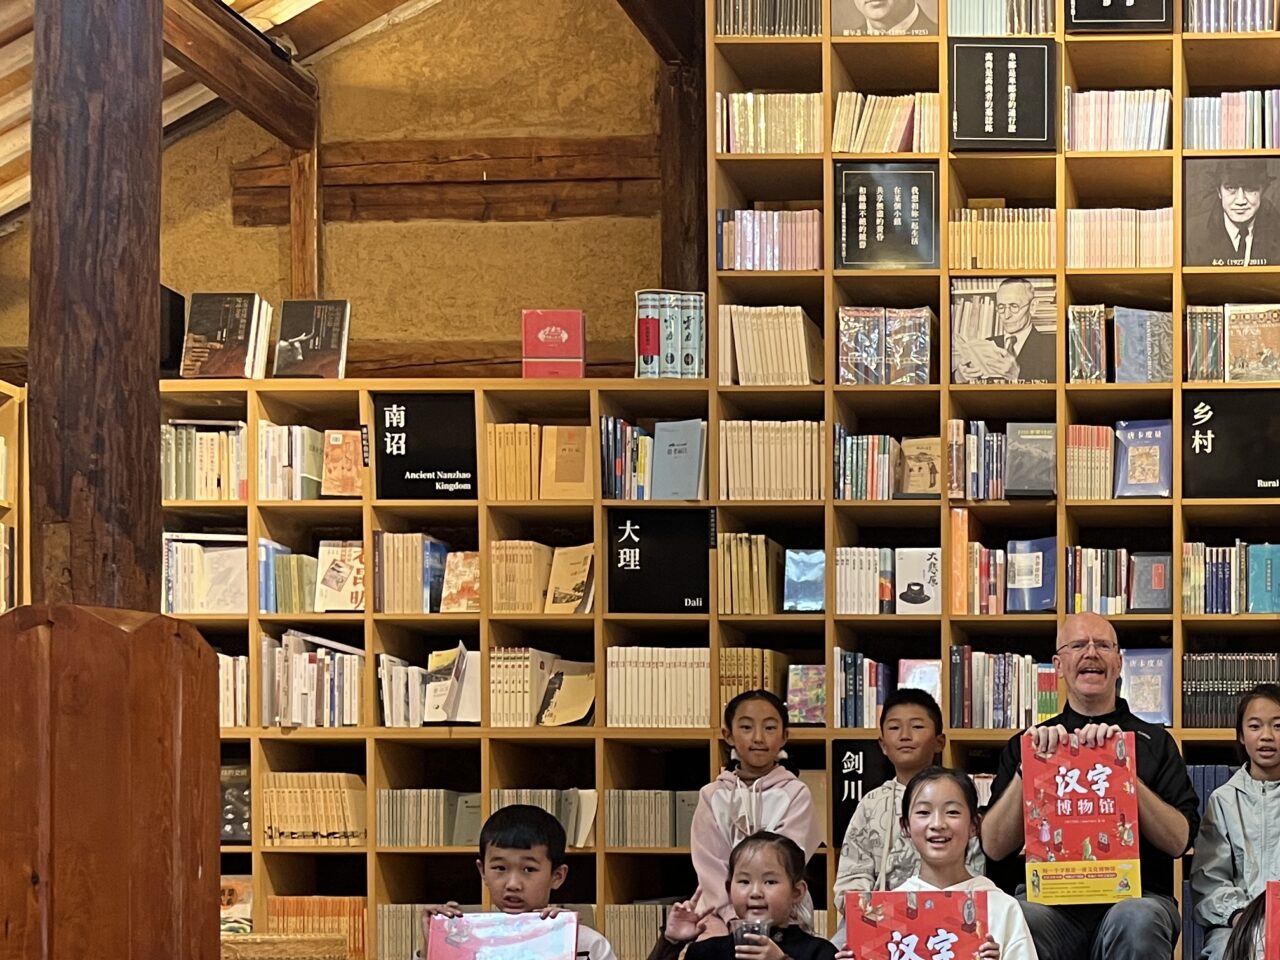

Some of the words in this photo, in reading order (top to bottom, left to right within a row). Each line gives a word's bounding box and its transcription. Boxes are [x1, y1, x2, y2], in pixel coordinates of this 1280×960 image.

[383, 403, 407, 456] 南诏
[1191, 401, 1215, 454] 乡村
[404, 470, 435, 480] Ancient
[437, 470, 471, 480] Nanzhao
[435, 481, 471, 492] Kingdom
[1256, 478, 1280, 488] Rural
[617, 519, 641, 570] 大理
[684, 597, 703, 607] Dali
[841, 751, 864, 802] 剑川
[1055, 763, 1113, 797] 汉字
[1056, 799, 1115, 816] 博物馆
